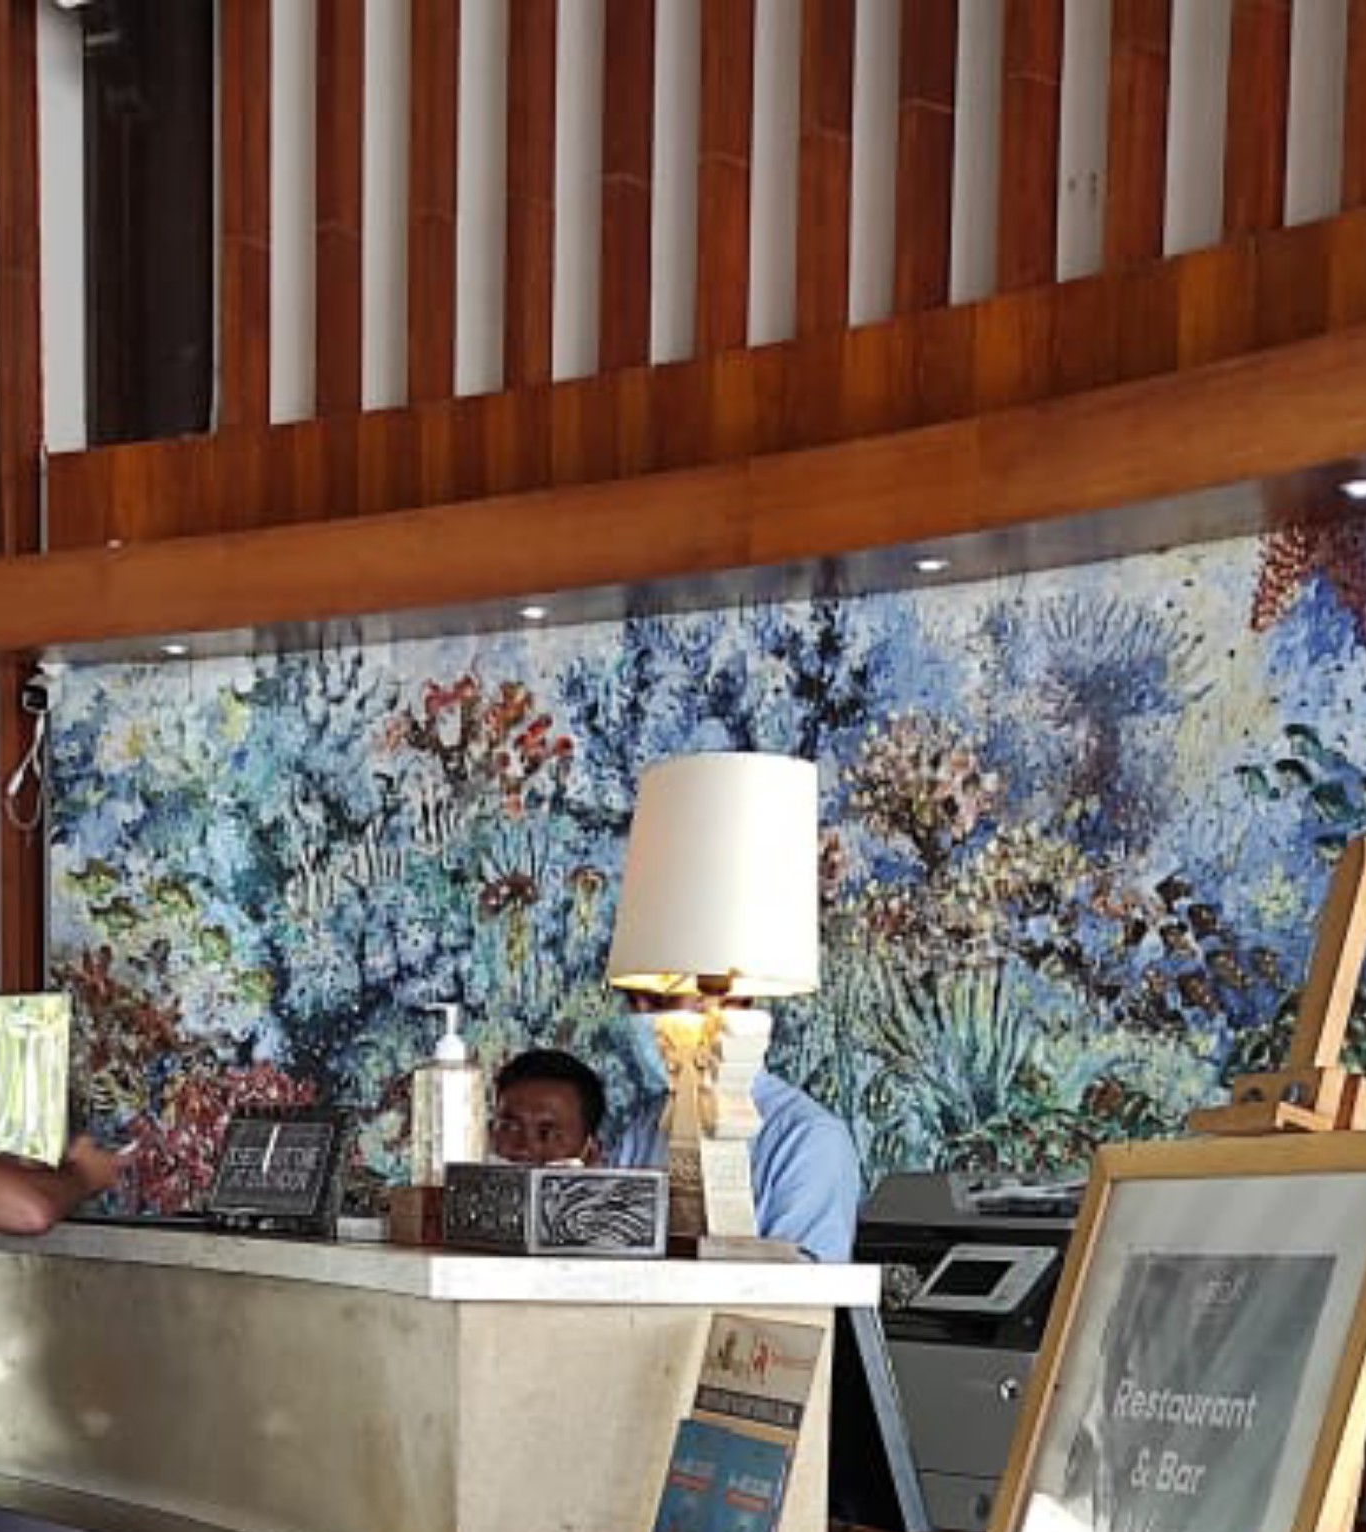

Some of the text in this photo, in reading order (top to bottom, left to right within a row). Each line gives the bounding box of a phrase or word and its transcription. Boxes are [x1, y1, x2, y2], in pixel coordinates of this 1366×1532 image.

[1112, 1377, 1259, 1430] Restaurant
[1130, 1448, 1208, 1494] & Bar
